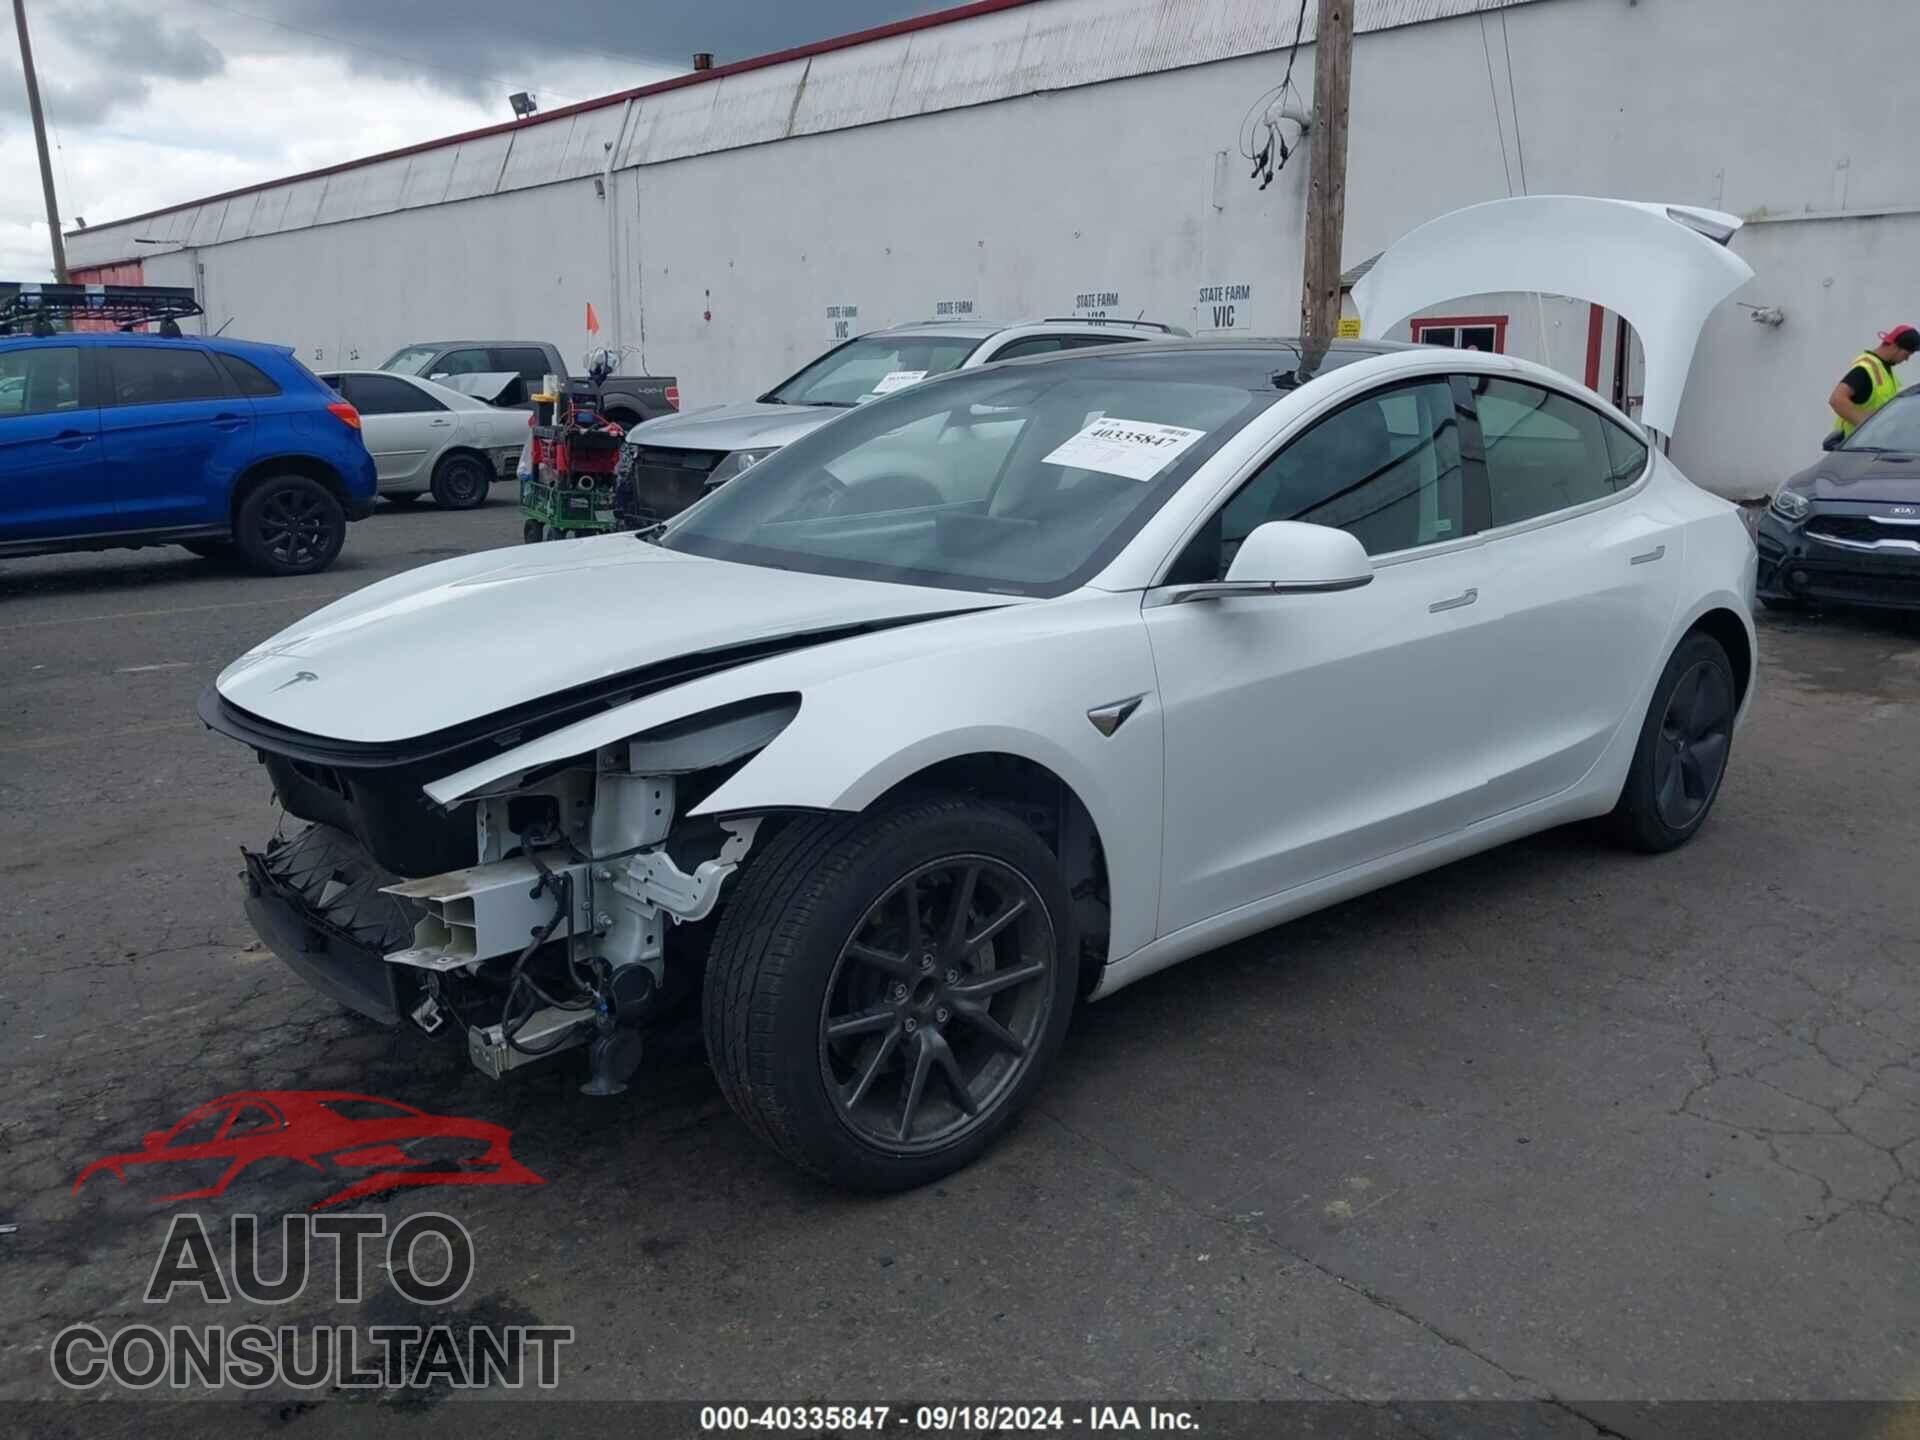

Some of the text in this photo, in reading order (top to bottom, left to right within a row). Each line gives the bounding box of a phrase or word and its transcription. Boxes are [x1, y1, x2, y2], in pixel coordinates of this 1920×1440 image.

[1076, 292, 1119, 308] STATE FARM
[1199, 285, 1251, 303] STATE FARM
[826, 306, 857, 318] STATE FARM
[936, 301, 973, 315] STATE FARM
[1213, 305, 1235, 328] VIC
[835, 320, 849, 338] VIC
[1091, 428, 1179, 448] 40335847
